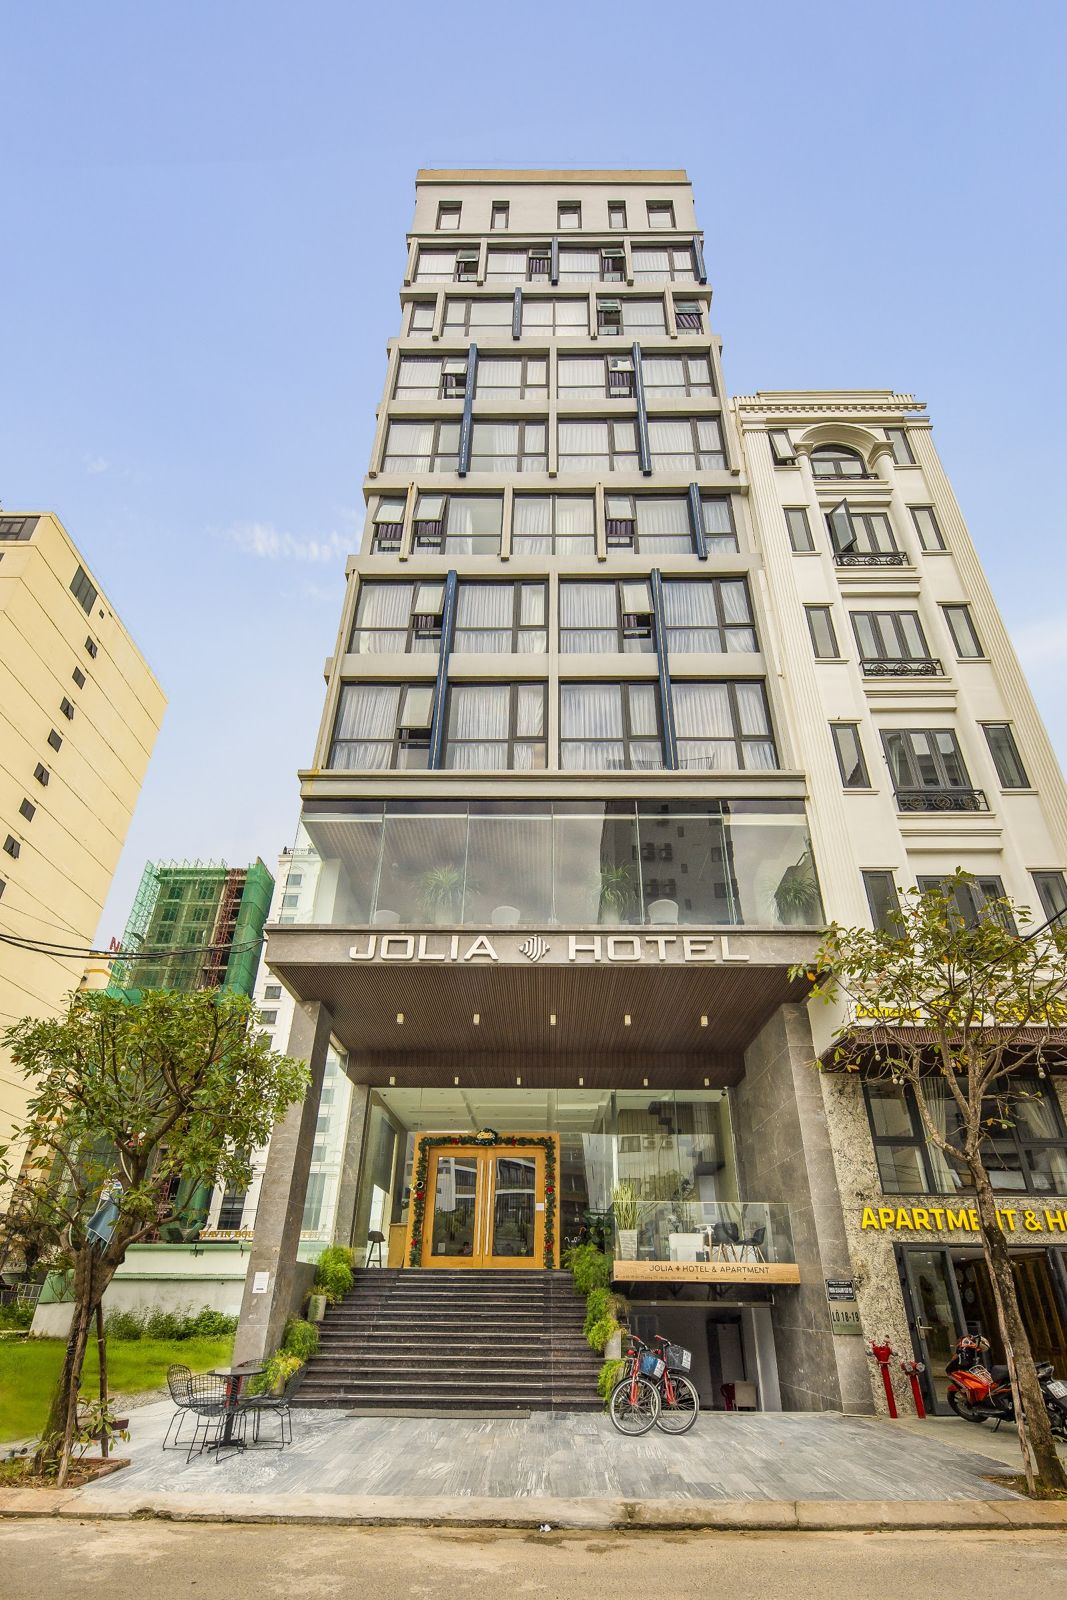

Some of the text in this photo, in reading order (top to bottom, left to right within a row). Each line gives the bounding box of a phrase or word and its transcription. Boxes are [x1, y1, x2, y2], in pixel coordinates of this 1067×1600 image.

[349, 934, 750, 962] JOLIA HOTEL
[1024, 1209, 1043, 1232] &
[649, 1264, 770, 1274] JOLIA HOTEL & APARTMENT
